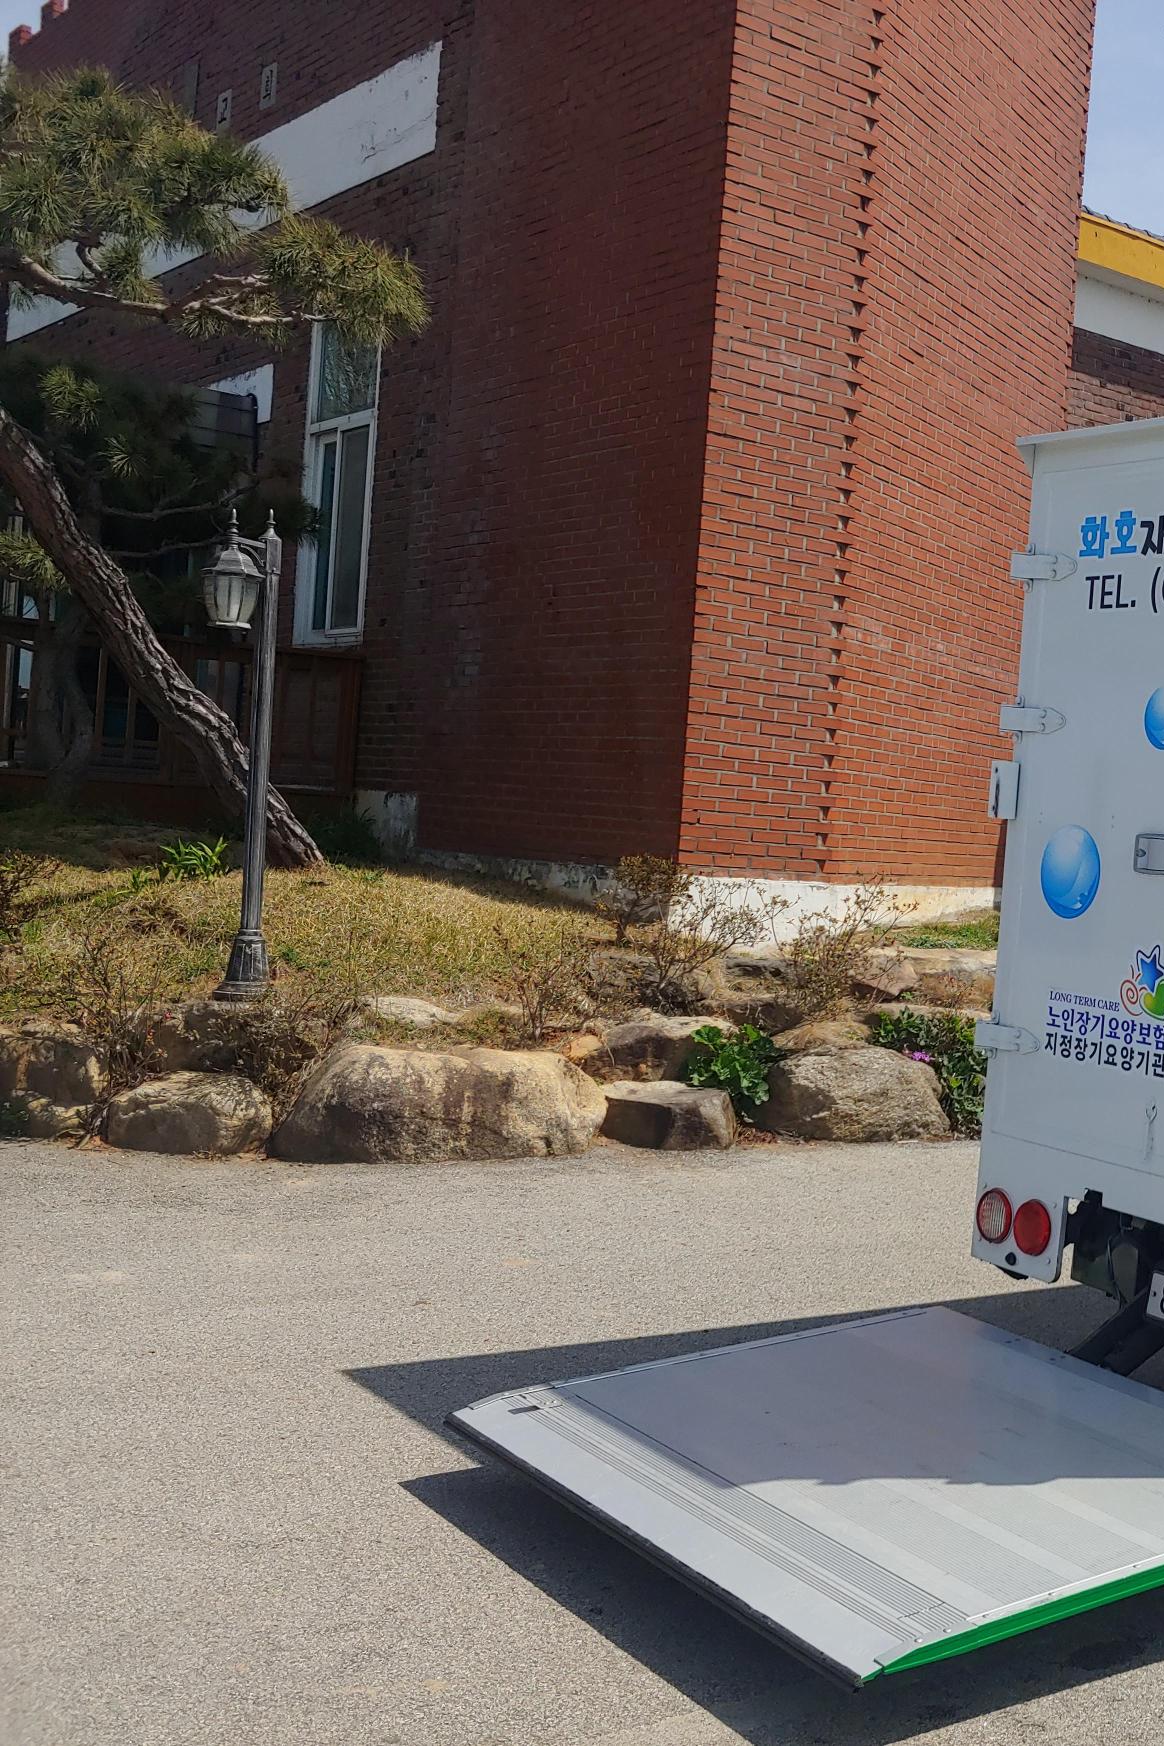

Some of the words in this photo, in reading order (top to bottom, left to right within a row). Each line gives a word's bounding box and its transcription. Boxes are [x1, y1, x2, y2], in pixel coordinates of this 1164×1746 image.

[1085, 574, 1137, 611] TEL.
[1049, 990, 1073, 1003] LONG
[1073, 995, 1097, 1008] TERM
[1097, 999, 1120, 1012] CARE
